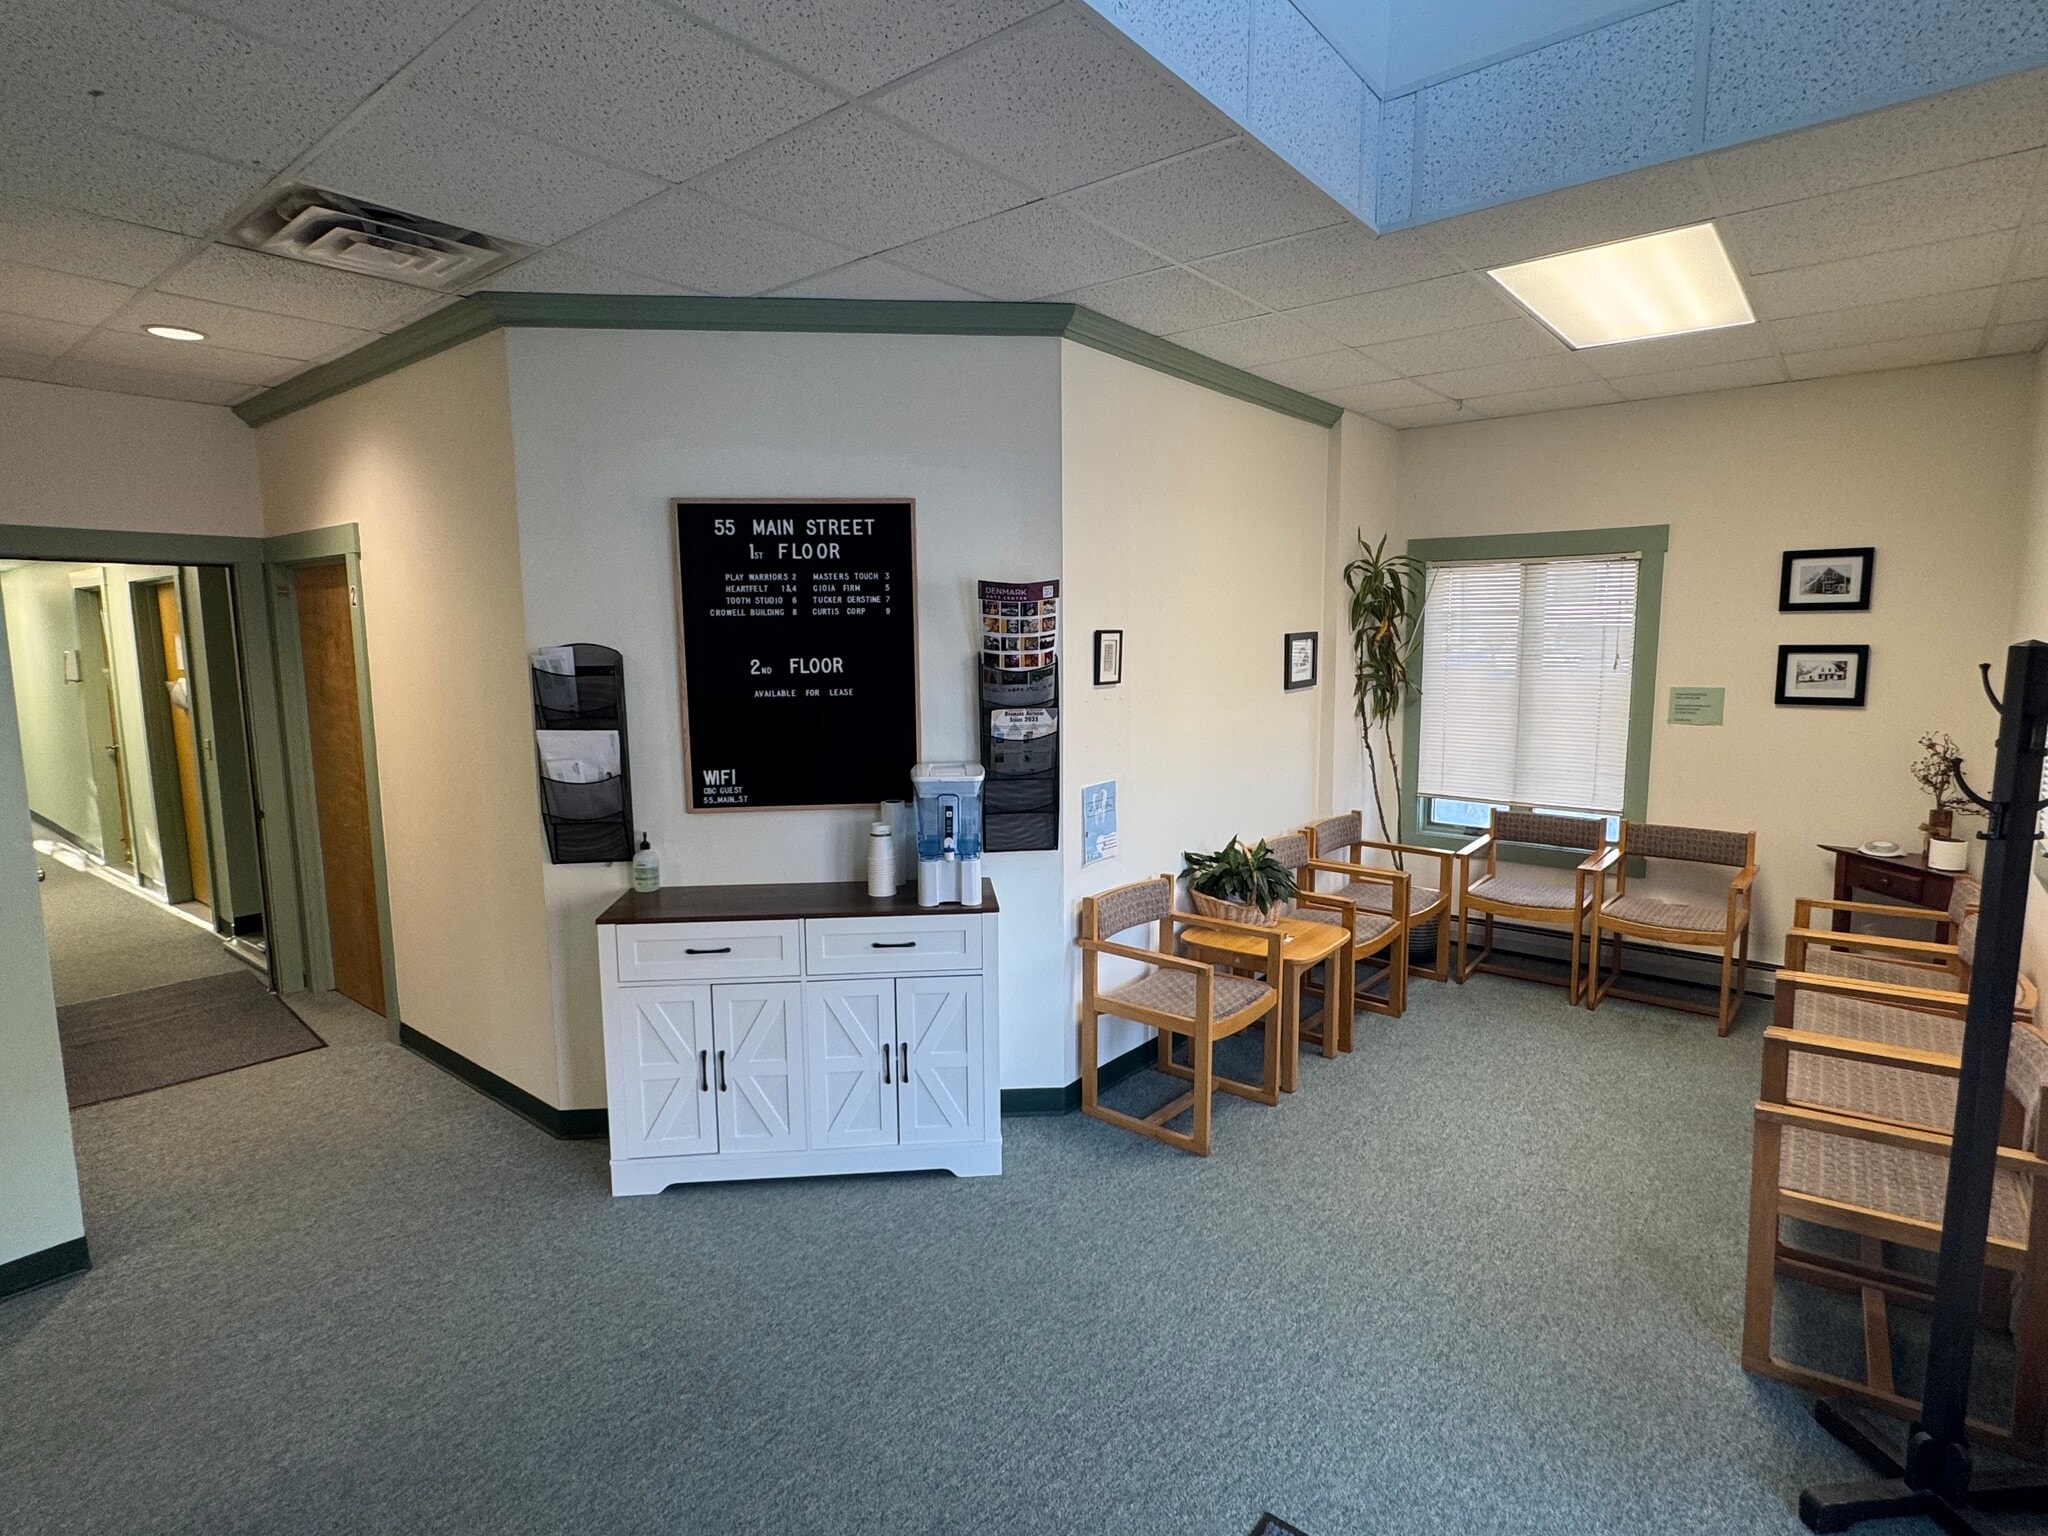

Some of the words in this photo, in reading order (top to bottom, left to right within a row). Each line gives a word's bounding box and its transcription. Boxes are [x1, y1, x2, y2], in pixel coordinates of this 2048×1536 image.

[714, 519, 736, 536] 55
[752, 518, 794, 536] MAIN
[805, 518, 875, 536] STREET
[748, 543, 764, 560] 1ST
[778, 542, 841, 560] FLOOR
[724, 573, 744, 582] PLAY
[748, 572, 789, 582] WARRIORS
[791, 573, 797, 581] 2
[812, 572, 850, 581] MASTERS
[853, 572, 879, 581] TOUCH
[884, 572, 890, 580] 3
[725, 584, 769, 593] HEARTFELT
[812, 584, 836, 593] GIOIA
[842, 584, 861, 592] FIRM
[884, 583, 890, 592] 5
[985, 586, 1027, 596] DENMARK
[725, 596, 751, 605] TOOTH
[754, 596, 784, 605] STUDIO
[812, 595, 843, 604] TUCKER
[846, 595, 882, 604] DERSTINE
[885, 595, 891, 603] 7
[709, 608, 746, 617] CROWELL
[749, 608, 785, 617] BUILDING
[811, 607, 840, 616] CURTIS
[846, 607, 866, 616] CORP
[750, 658, 773, 675] 2ND
[789, 657, 844, 674] FLOOR
[754, 689, 796, 698] AVAILABLE
[805, 688, 820, 697] FOR
[829, 688, 854, 697] LEASE
[703, 768, 736, 786] WIFI
[719, 786, 743, 795] GUEST
